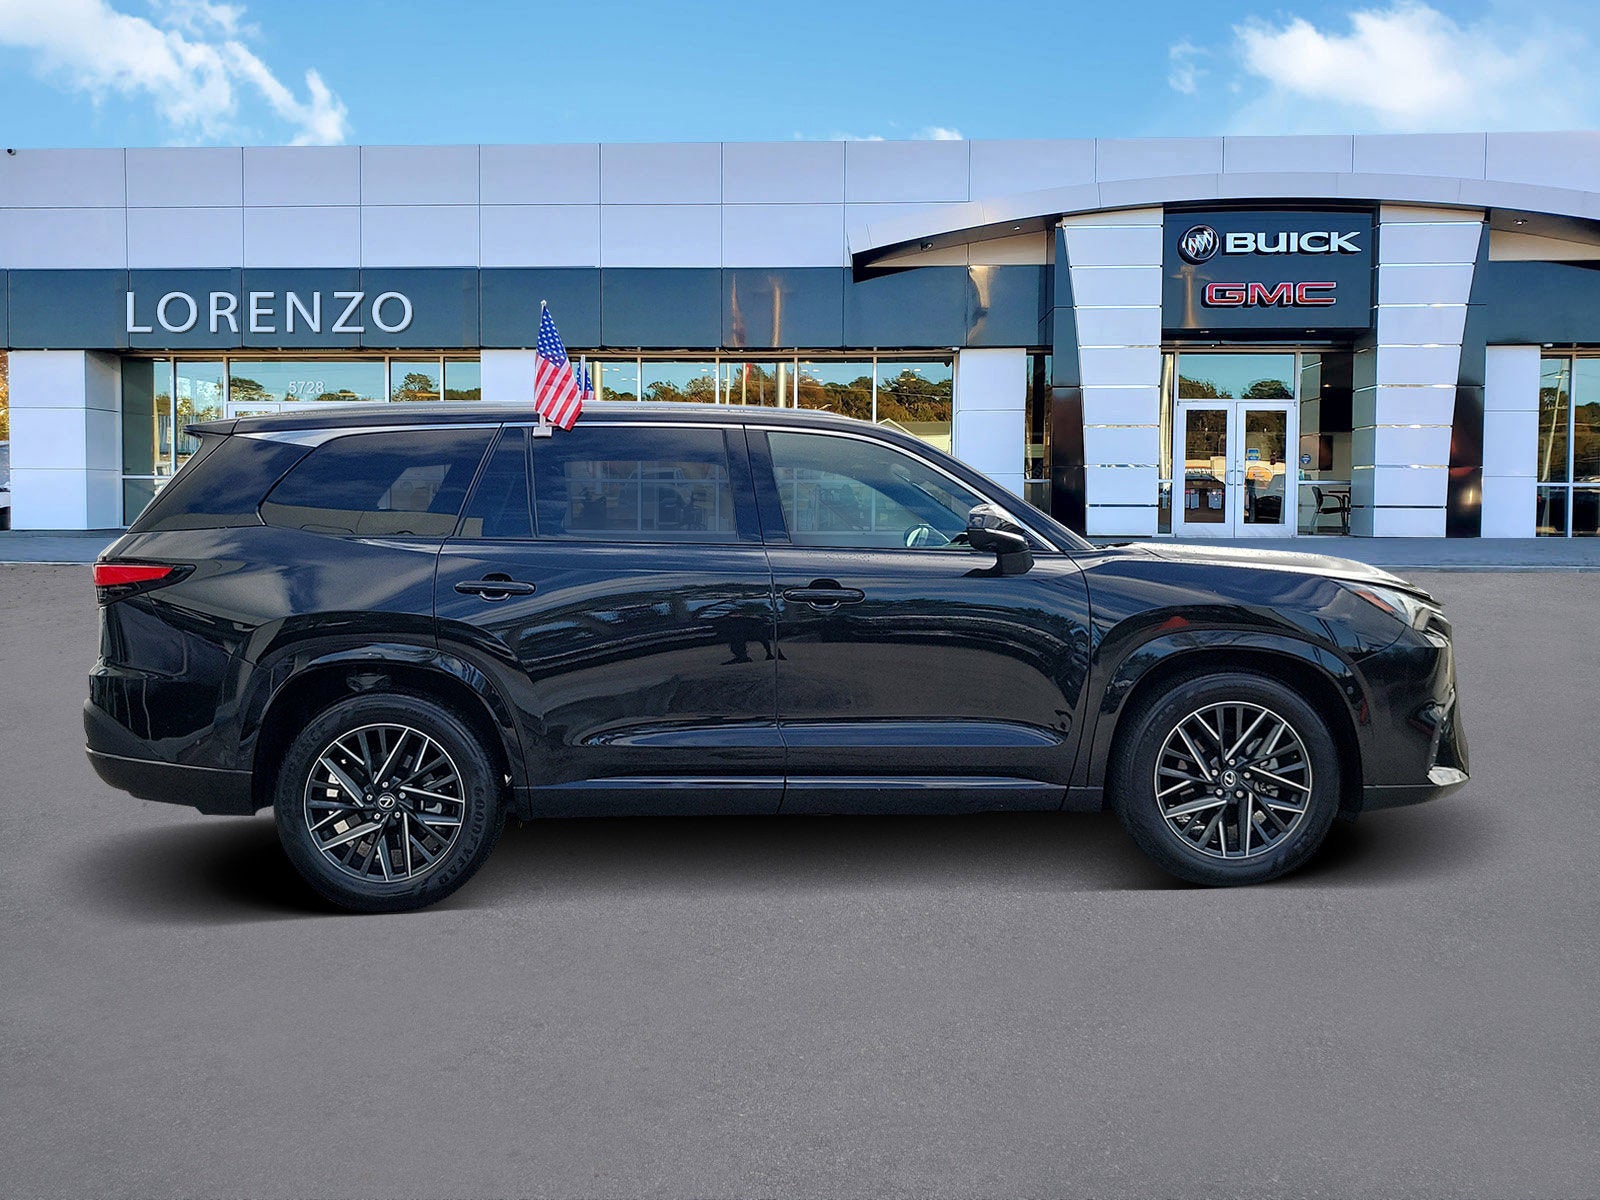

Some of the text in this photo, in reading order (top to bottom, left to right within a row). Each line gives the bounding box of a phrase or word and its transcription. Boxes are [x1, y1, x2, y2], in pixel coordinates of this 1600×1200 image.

[1225, 231, 1362, 253] BUICK
[1206, 282, 1337, 305] GMC
[126, 291, 413, 333] LORENZO
[287, 381, 325, 394] 5728
